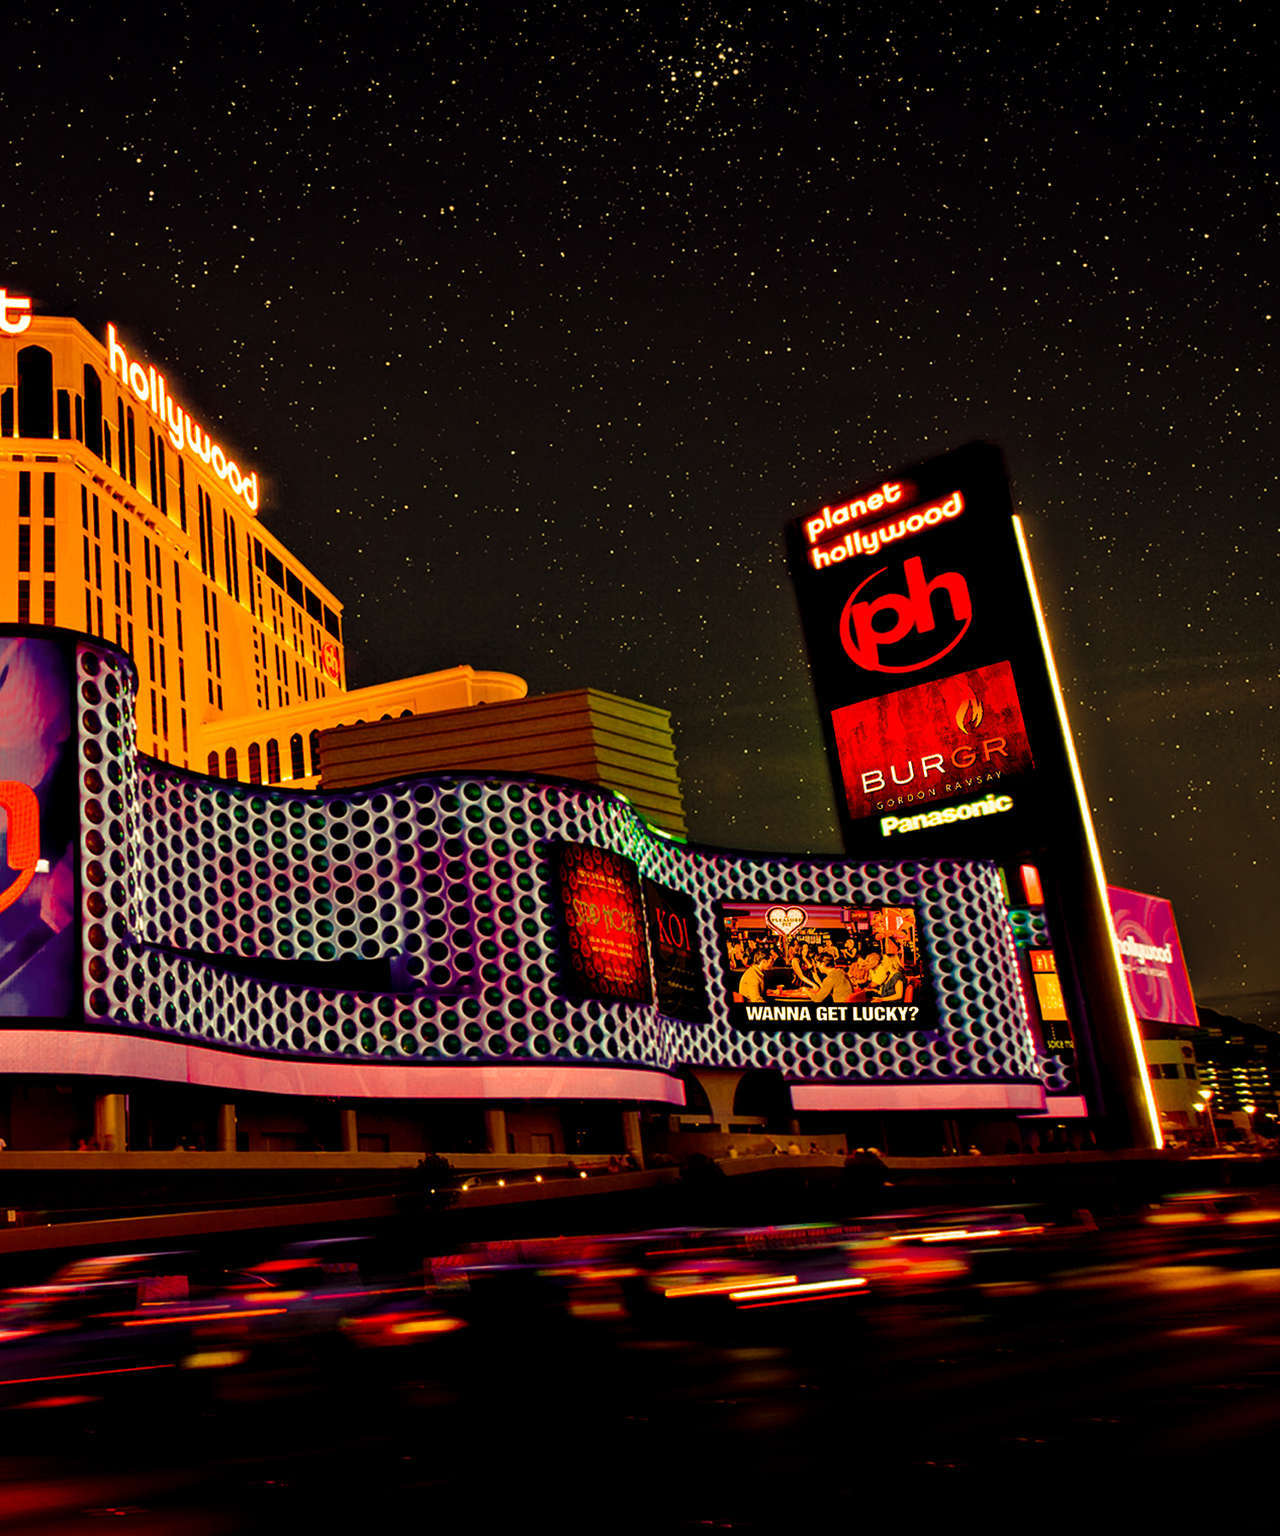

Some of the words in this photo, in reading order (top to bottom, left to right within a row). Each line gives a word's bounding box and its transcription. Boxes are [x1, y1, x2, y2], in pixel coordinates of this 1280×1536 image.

[106, 323, 259, 511] hollywood
[807, 483, 902, 543] planet
[811, 492, 963, 569] hollywood
[849, 556, 972, 672] ph
[861, 737, 1009, 794] BURGR
[876, 788, 936, 810] GORDON
[881, 794, 1013, 837] Panasonic
[656, 908, 691, 951] KOI
[745, 1006, 811, 1021] WANNA
[816, 1006, 847, 1021] GET
[853, 1006, 919, 1021] LUCKY?
